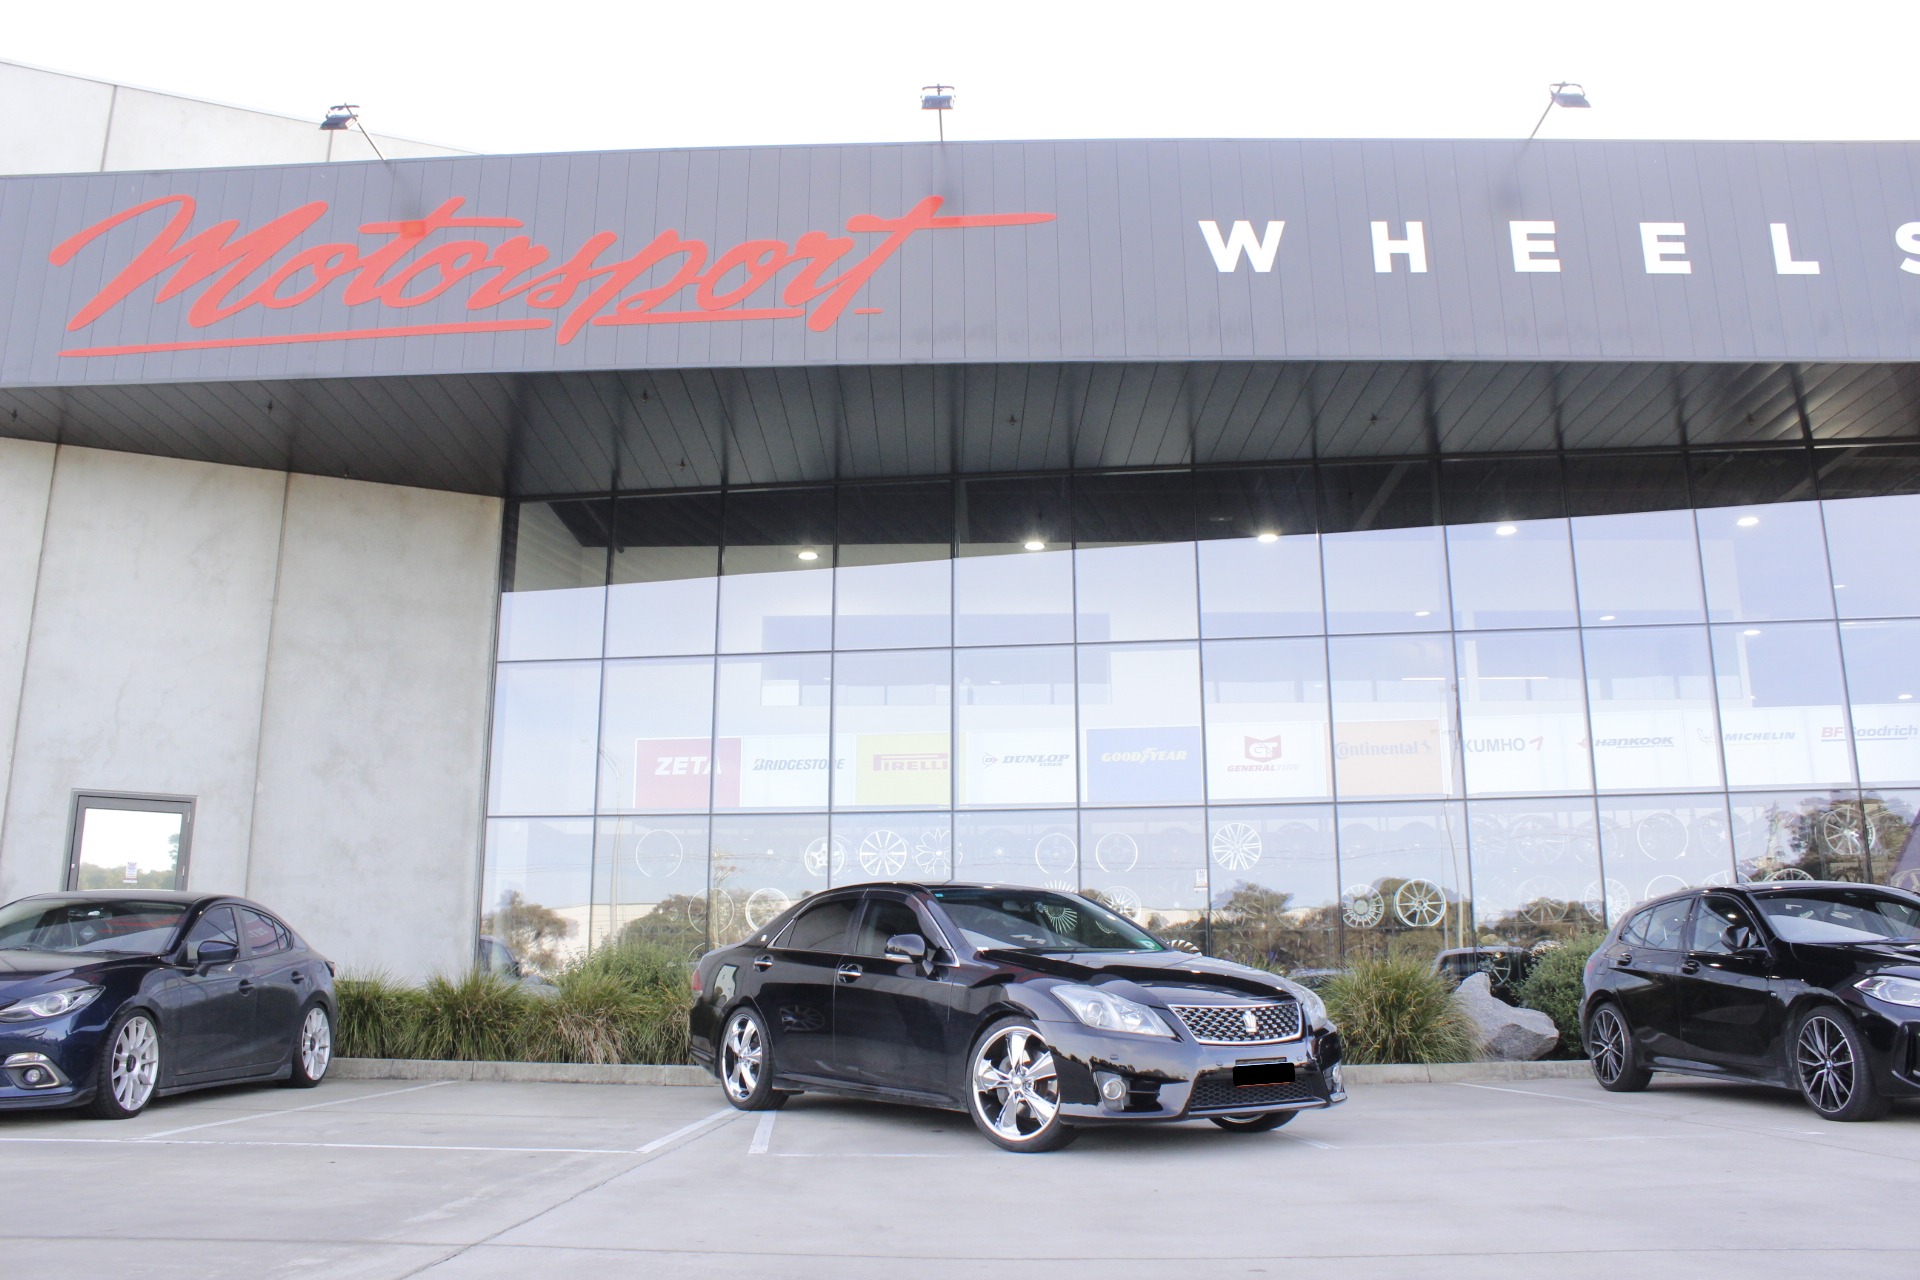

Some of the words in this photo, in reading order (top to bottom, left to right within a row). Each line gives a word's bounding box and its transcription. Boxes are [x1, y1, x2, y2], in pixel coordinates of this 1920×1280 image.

[49, 194, 1056, 346] Motorsport
[1724, 731, 1796, 742] MICHELIN
[1821, 725, 1918, 739] BFoodrich
[1335, 740, 1418, 760] Continental
[1463, 737, 1526, 753] KUMHO
[873, 752, 949, 771] PIRELLI
[1001, 754, 1070, 764] DUNLOP
[1101, 747, 1188, 764] GOODYEAR
[654, 755, 722, 776] ZETA
